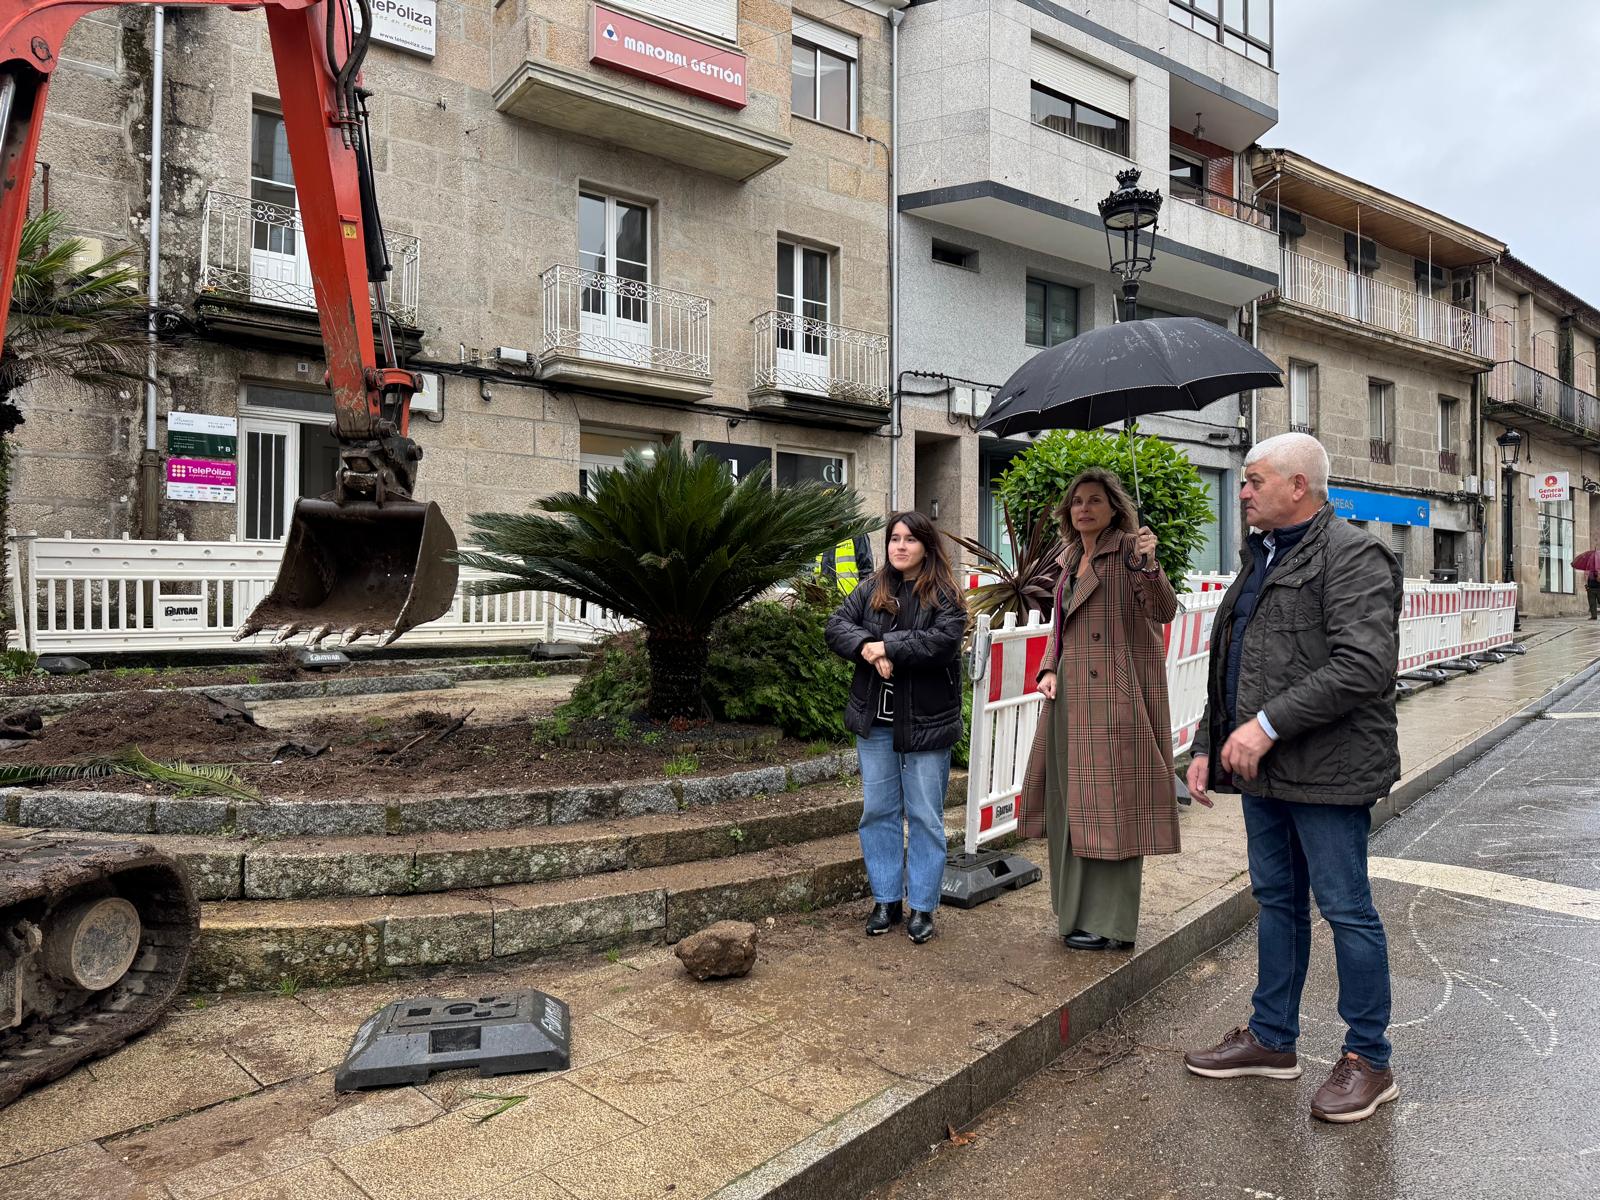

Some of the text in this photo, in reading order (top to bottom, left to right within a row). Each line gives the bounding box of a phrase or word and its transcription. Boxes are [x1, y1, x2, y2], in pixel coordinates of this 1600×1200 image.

[371, 0, 432, 26] lePóliza
[624, 36, 742, 87] MAROBAL GESTIÓN
[187, 465, 232, 477] TelePóliza
[1330, 498, 1354, 510] AREAS
